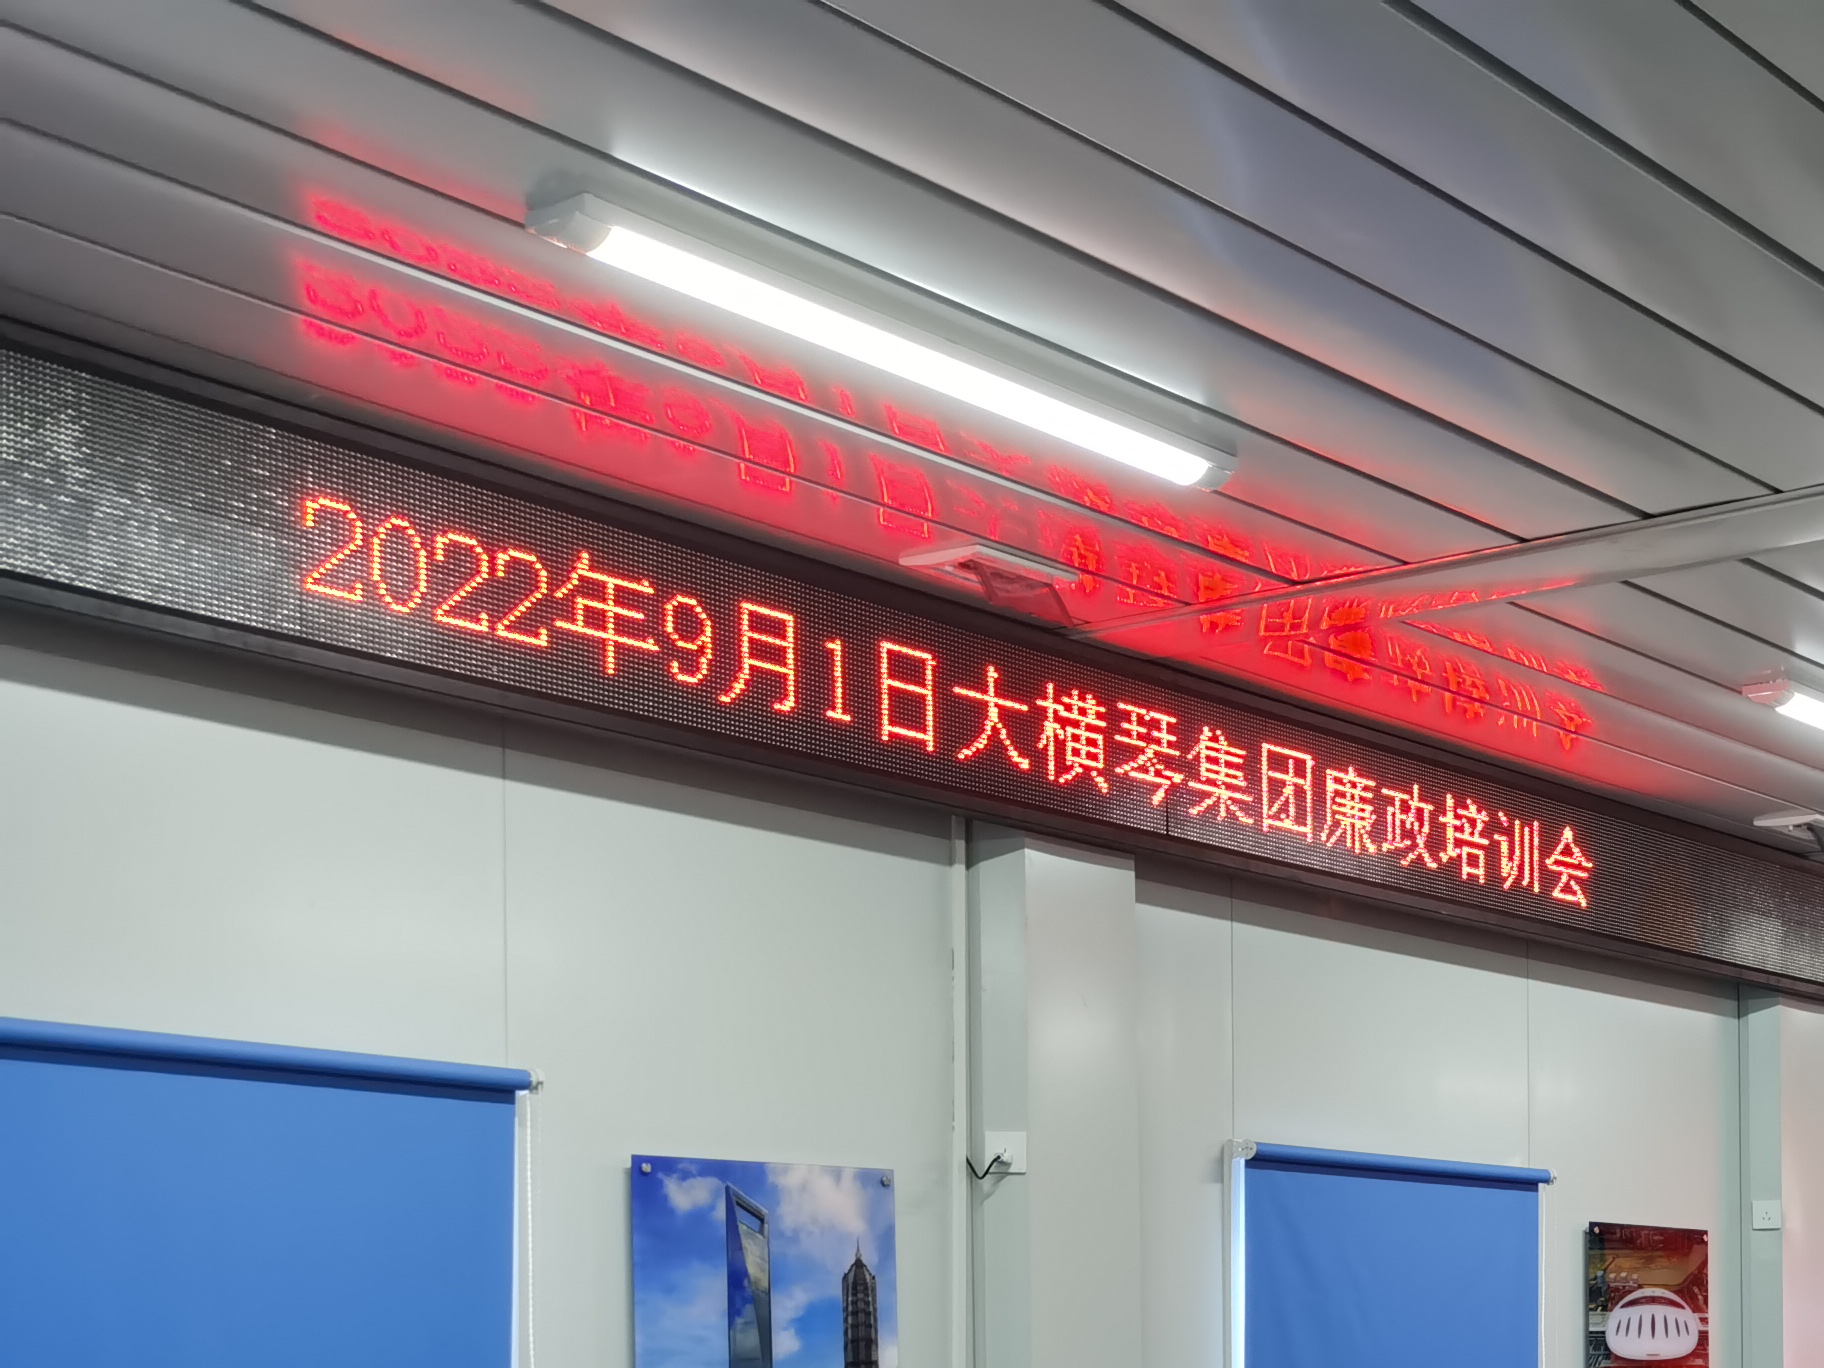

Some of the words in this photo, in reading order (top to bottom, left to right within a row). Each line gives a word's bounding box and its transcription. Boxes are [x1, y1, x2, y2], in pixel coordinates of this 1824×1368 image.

[300, 495, 1594, 909] 2022年9月1日大横琴集团廉政培训会
